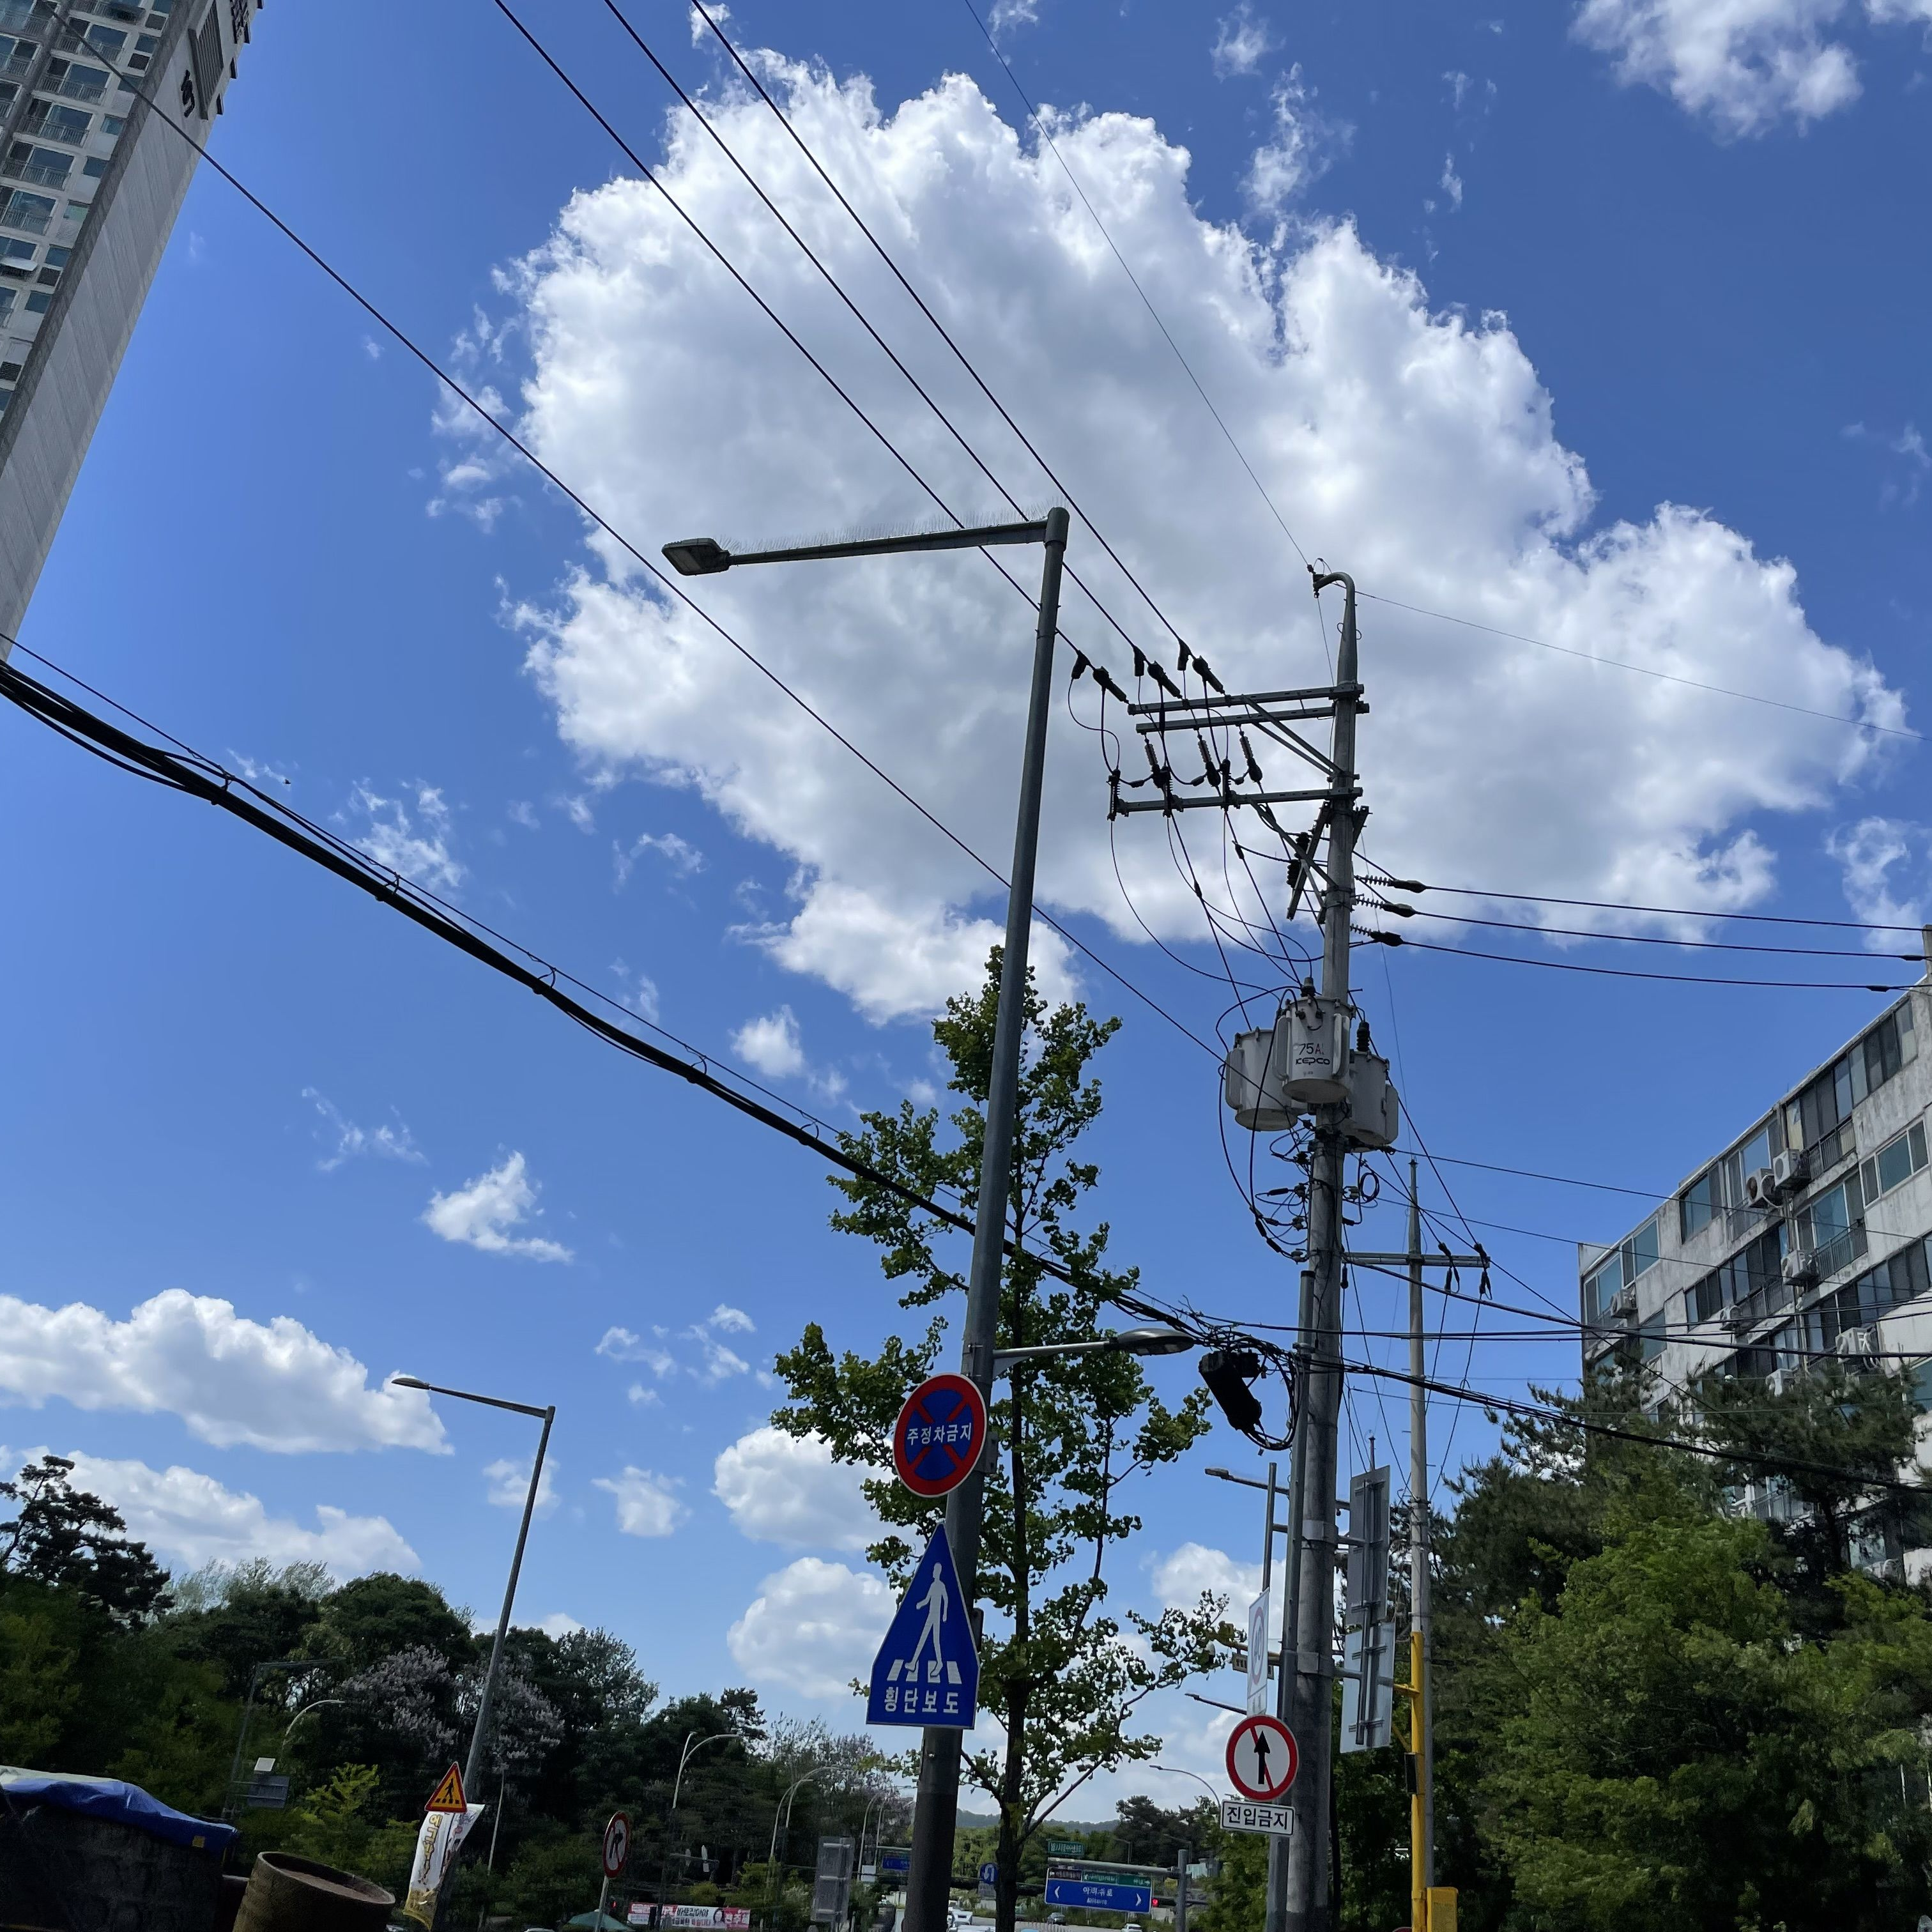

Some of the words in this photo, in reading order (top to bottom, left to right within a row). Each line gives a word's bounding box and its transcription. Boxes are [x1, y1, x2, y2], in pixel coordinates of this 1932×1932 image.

[907, 1422, 972, 1445] 주정차금지
[884, 1687, 958, 1713] 횡단보도
[1227, 1806, 1287, 1830] 진입금지
